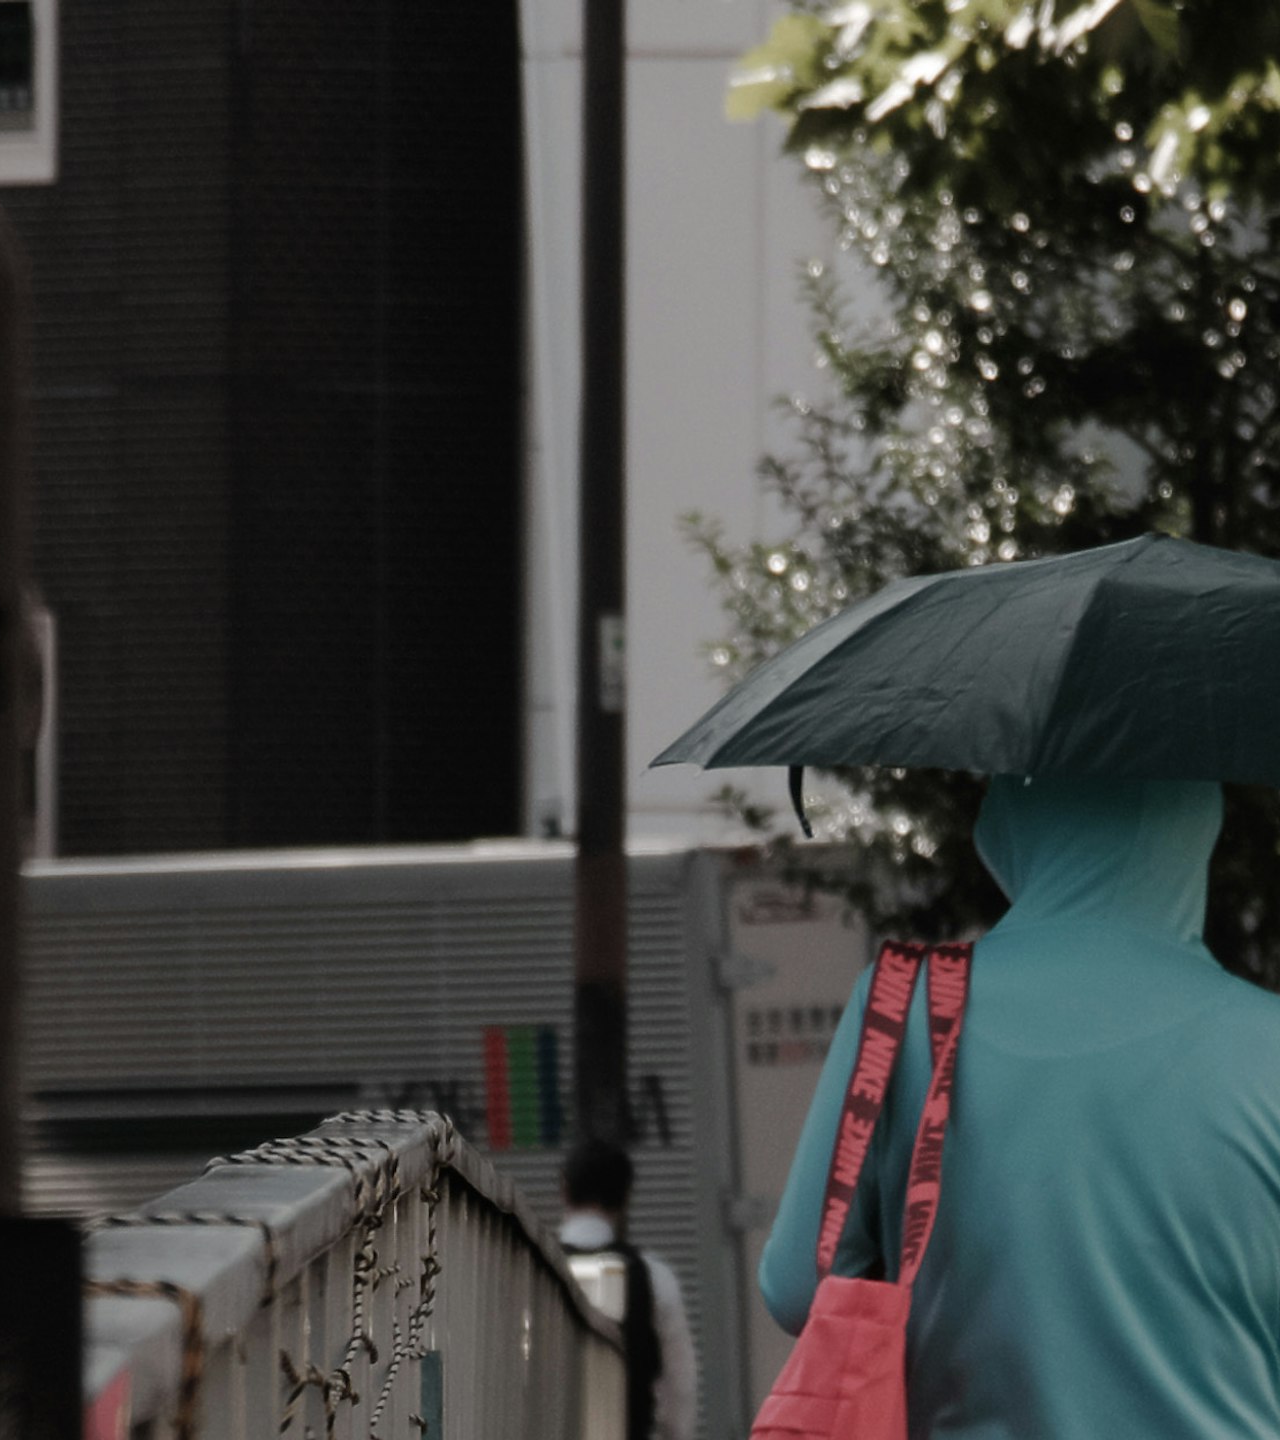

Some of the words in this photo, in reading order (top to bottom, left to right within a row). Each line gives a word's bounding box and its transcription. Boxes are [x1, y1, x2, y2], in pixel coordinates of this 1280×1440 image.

[869, 946, 921, 1023] NIKE
[928, 949, 970, 1019] NIKE
[851, 1027, 899, 1104] NIKE
[832, 1111, 876, 1187] NIKE
